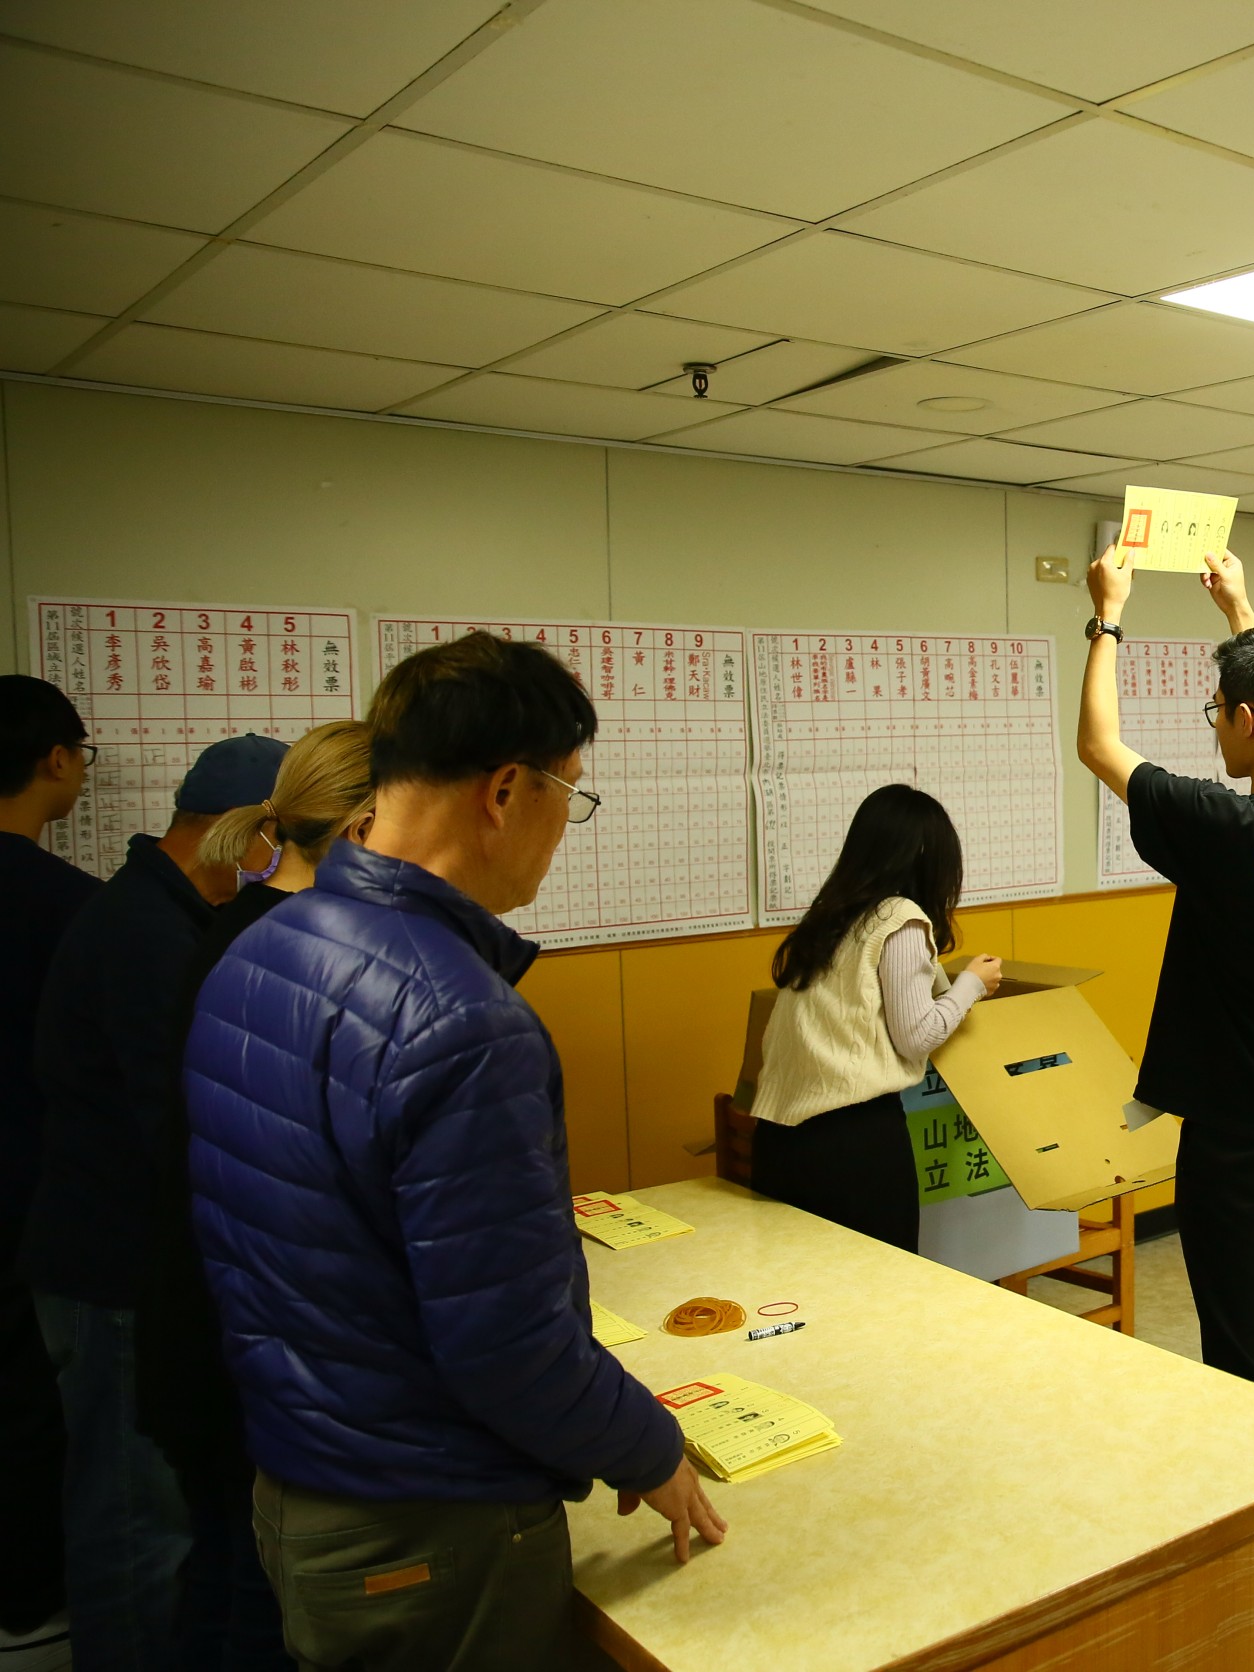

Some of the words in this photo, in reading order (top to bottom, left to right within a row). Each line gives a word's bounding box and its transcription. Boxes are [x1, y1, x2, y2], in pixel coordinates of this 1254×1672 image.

[105, 610, 116, 628] 1
[152, 612, 166, 629] 2
[197, 613, 211, 630] 3
[240, 615, 253, 632] 4
[283, 616, 296, 633] 5
[431, 625, 440, 641] 1
[502, 627, 512, 642] 3
[536, 628, 547, 643] 4
[569, 629, 579, 644] 5
[602, 630, 611, 645] 6
[633, 631, 643, 646] 7
[664, 632, 673, 647] 8
[694, 633, 703, 648] 9
[46, 610, 63, 690] 第11屆區域立法
[792, 638, 799, 651] 1
[818, 638, 827, 651] 2
[845, 638, 853, 651] 3
[870, 639, 879, 651] 4
[896, 639, 904, 652] 5
[920, 640, 928, 653] 6
[944, 641, 952, 653] 7
[968, 641, 975, 653] 8
[990, 641, 998, 654] 9
[1010, 642, 1024, 654] 10
[1126, 644, 1132, 656] 1
[1144, 644, 1151, 656] 2
[1163, 645, 1169, 656] 3
[1181, 645, 1188, 656] 4
[1199, 645, 1206, 656] 5
[104, 633, 124, 691] 李彥秀
[151, 635, 172, 691] 吳欣岱
[196, 636, 216, 692] 高嘉瑜
[281, 639, 301, 692] 林秋彤
[323, 640, 340, 693] 無效票
[688, 652, 700, 699] 鄭天財
[722, 654, 735, 698] 無效票
[790, 656, 803, 699] 林世偉
[990, 659, 1001, 698] 孔文吉
[924, 1114, 979, 1151] 山地
[924, 1148, 990, 1193] 立法
